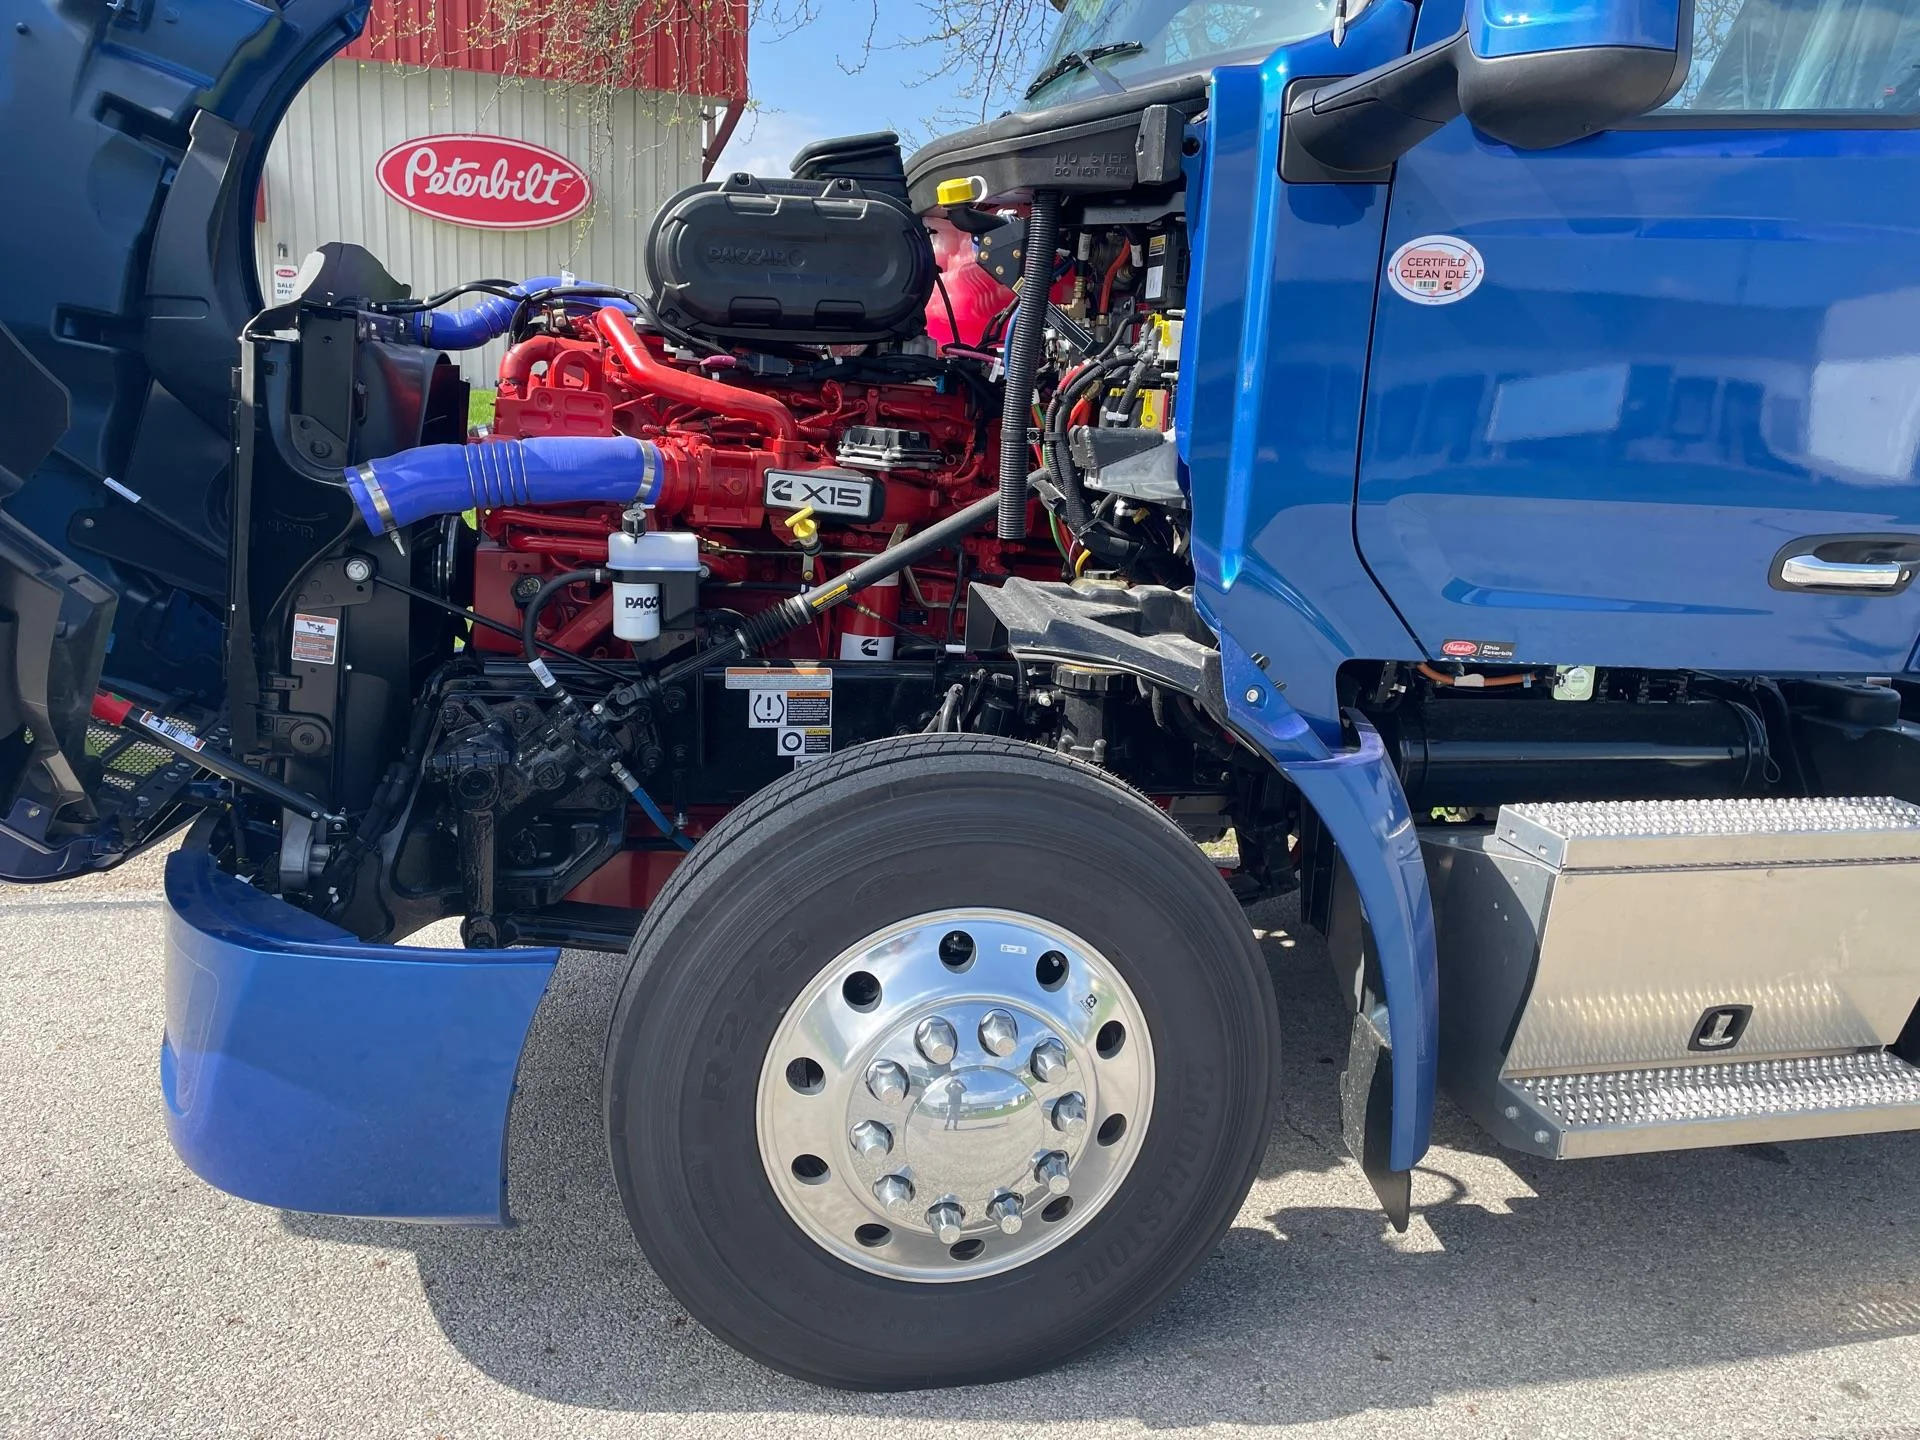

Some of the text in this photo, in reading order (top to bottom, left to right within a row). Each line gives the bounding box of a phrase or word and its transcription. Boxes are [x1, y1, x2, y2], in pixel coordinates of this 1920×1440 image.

[1089, 152, 1128, 165] STEP
[405, 147, 573, 205] Peterbilt
[1055, 166, 1071, 177] DO
[1407, 257, 1466, 267] CERTIFIED
[1400, 269, 1470, 279] CLEAN IDLE
[799, 483, 862, 507] X15
